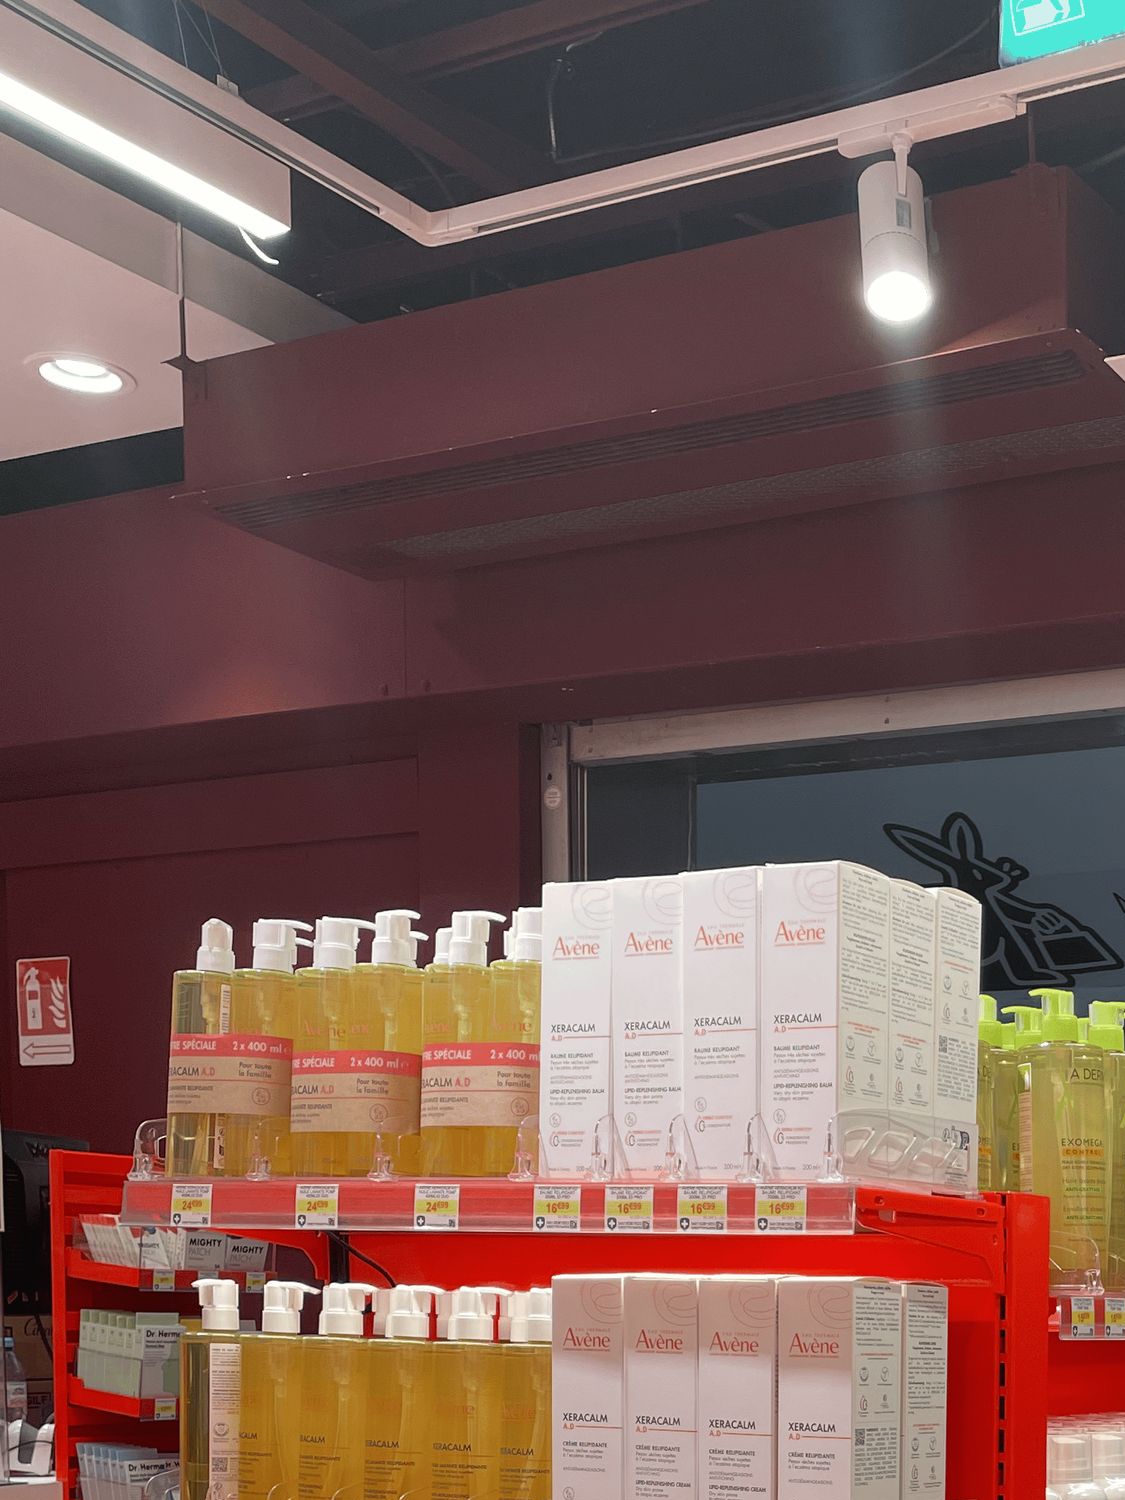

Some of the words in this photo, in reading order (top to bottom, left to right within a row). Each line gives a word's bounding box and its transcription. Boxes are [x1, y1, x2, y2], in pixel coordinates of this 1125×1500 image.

[694, 924, 745, 948] Avène
[774, 919, 826, 944] Avène
[552, 934, 600, 958] Avène
[624, 931, 673, 954] Avène
[693, 1015, 742, 1028] XERACALM
[773, 1012, 822, 1024] XERACALM
[550, 1022, 596, 1034] XERACALM
[624, 1019, 671, 1032] XERACALM
[182, 1039, 216, 1051] SPÉCIALE
[233, 1041, 238, 1051] 2
[248, 1042, 267, 1053] 400
[270, 1044, 282, 1053] ml
[438, 1049, 471, 1061] SPÉCIALE
[490, 1050, 496, 1060] 2
[506, 1050, 525, 1061] 400
[302, 1057, 335, 1068] SPÉCIALE
[350, 1058, 355, 1067] 2
[365, 1058, 384, 1068] 400
[386, 1059, 399, 1069] ml
[247, 1070, 272, 1079] famille
[455, 1077, 471, 1088] A.D
[426, 1200, 449, 1212] 24€99
[190, 1238, 222, 1247] MIGHTY
[232, 1245, 264, 1254] MIGHTY
[563, 1329, 611, 1349] Avène
[635, 1329, 683, 1351] Avène
[709, 1332, 759, 1354] Avène
[788, 1332, 839, 1355] Avène
[562, 1413, 608, 1423] XERACALM
[635, 1416, 681, 1426] XERACALM
[709, 1419, 756, 1430] XERACALM
[788, 1422, 836, 1433] XERACALM
